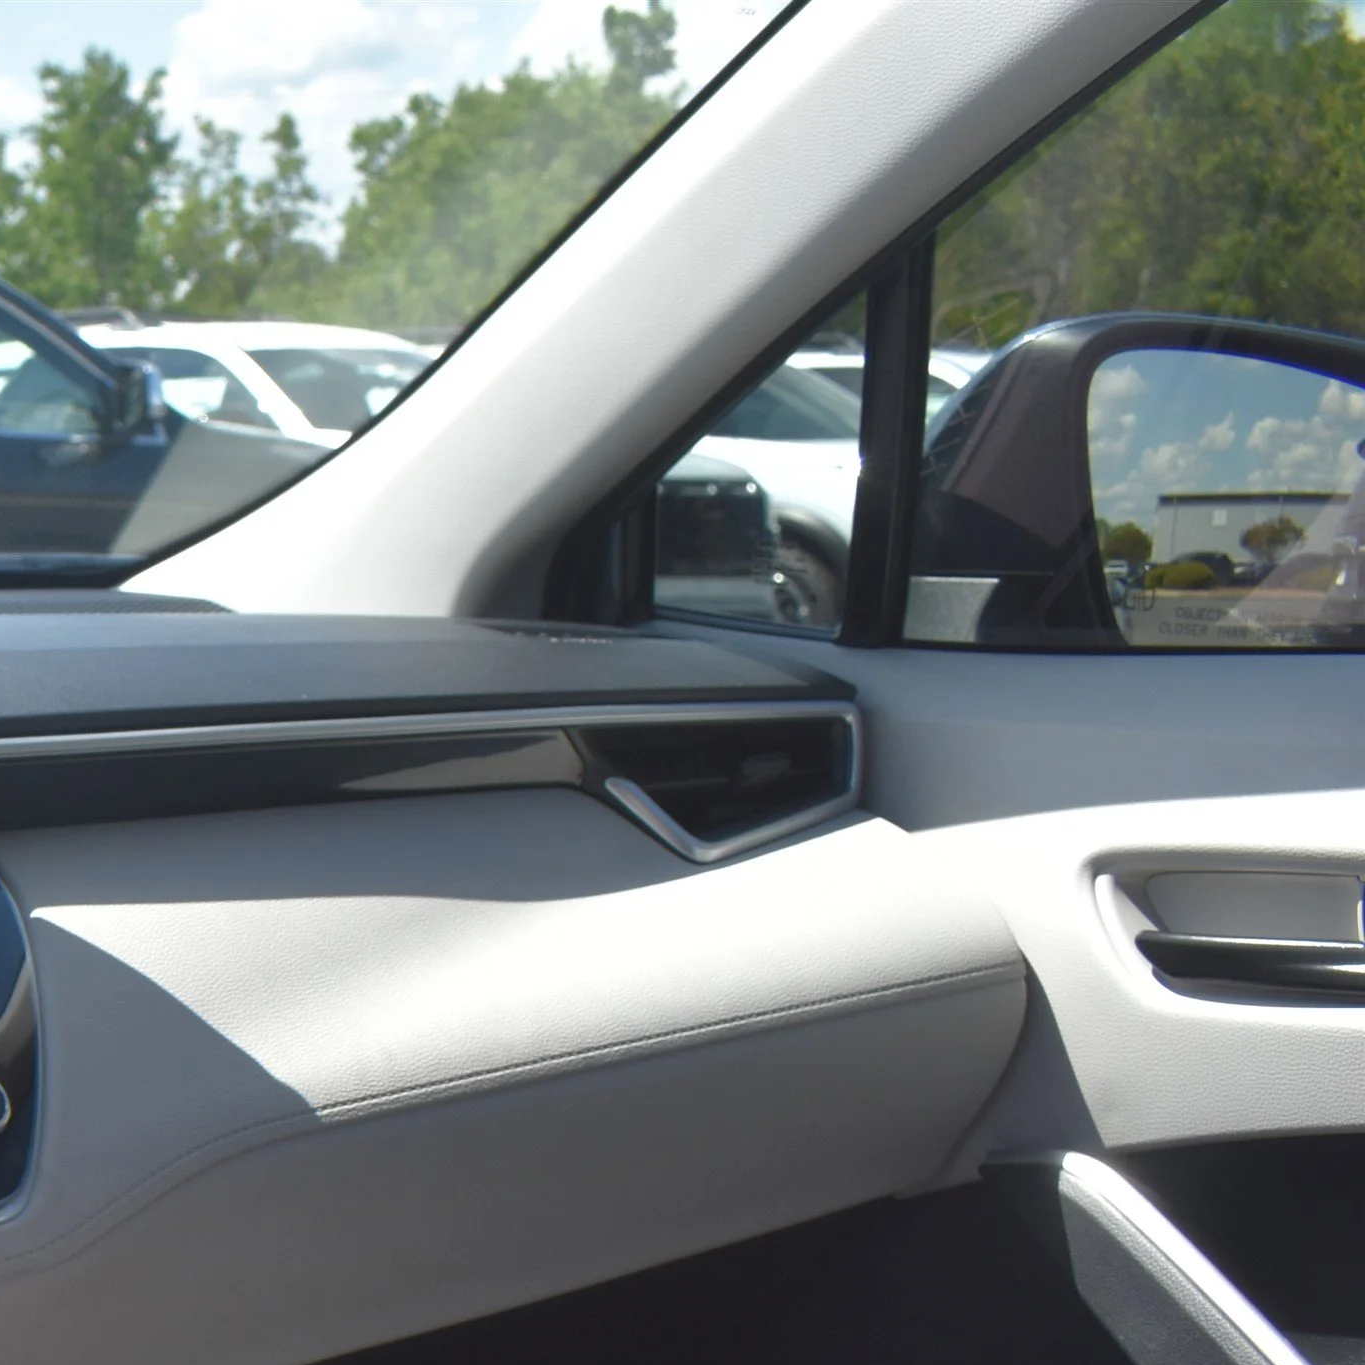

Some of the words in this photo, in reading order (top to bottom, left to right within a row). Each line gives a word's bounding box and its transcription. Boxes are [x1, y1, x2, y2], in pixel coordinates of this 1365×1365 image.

[1174, 606, 1233, 622] OBJECT
[1157, 622, 1209, 637] CLOSER
[1216, 626, 1249, 640] THAN
